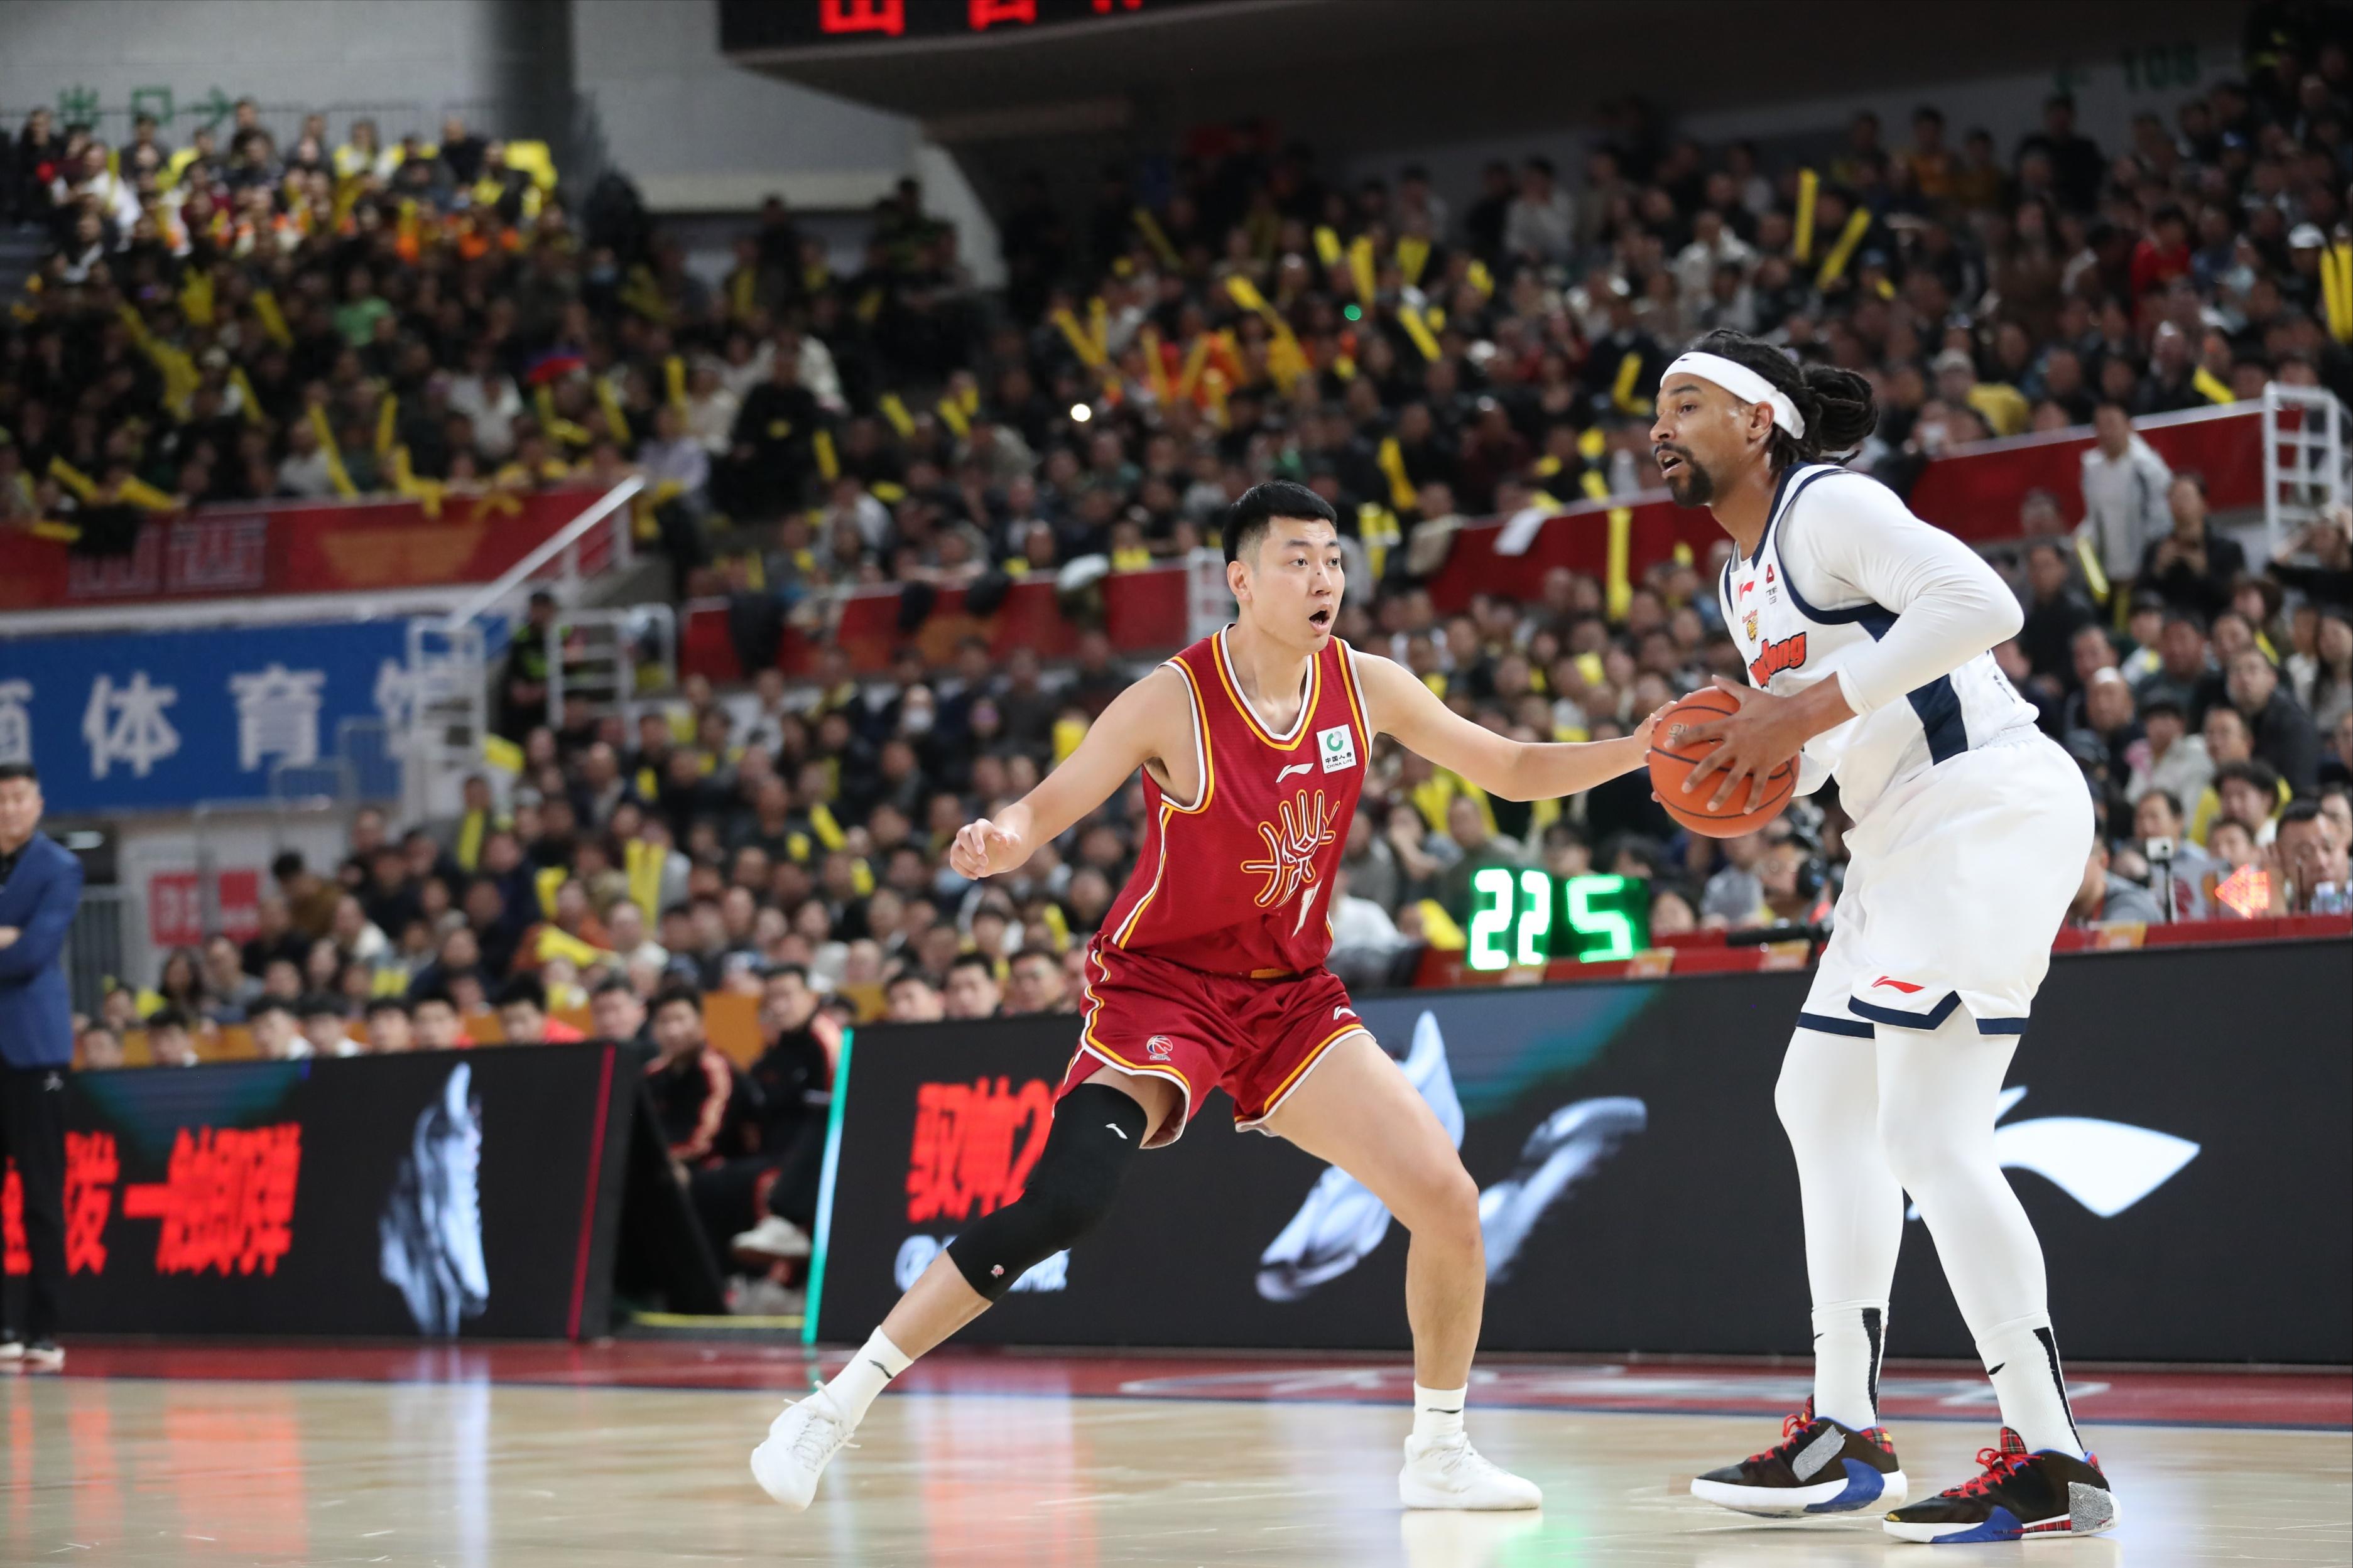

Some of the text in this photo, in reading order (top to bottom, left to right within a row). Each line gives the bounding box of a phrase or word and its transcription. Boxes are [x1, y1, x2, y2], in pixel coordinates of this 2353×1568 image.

[59, 84, 172, 130] 出口
[1325, 752, 1352, 764] 中国人寿
